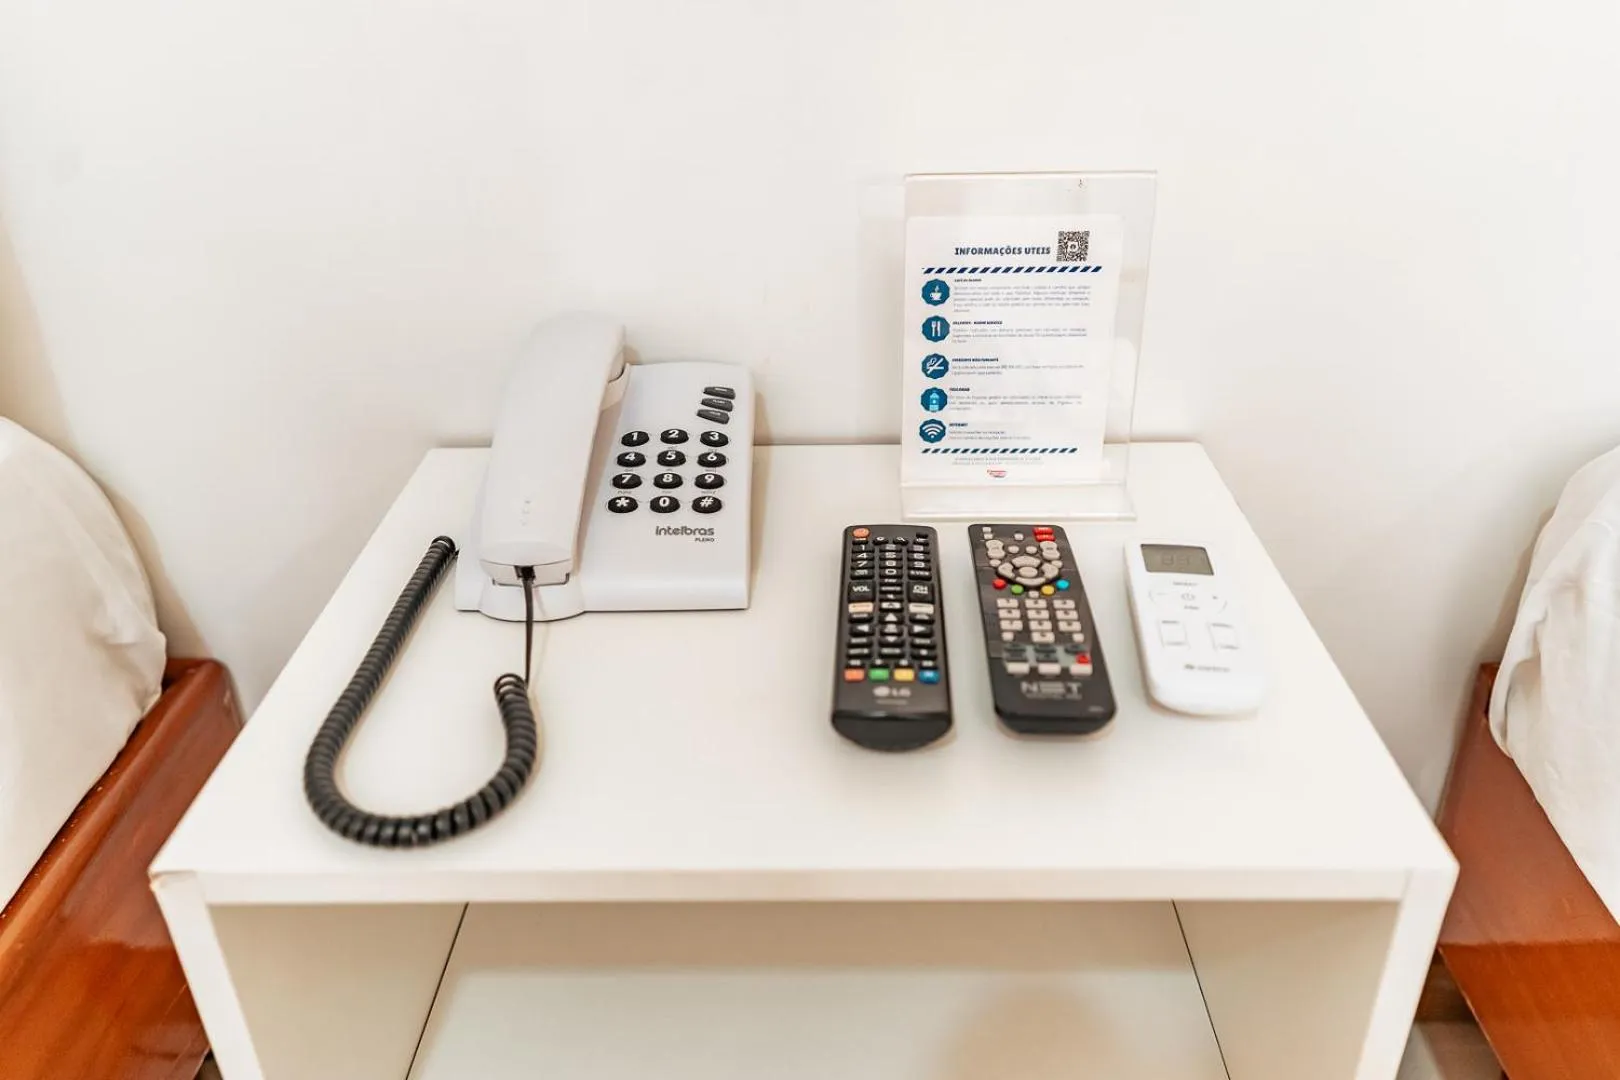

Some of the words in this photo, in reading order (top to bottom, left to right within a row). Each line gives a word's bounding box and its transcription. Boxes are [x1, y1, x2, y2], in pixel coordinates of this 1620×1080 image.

[954, 245, 1022, 256] INFORMAÇÕES
[1025, 246, 1051, 255] UTEIS
[632, 432, 638, 441] 1
[669, 430, 679, 438] 2
[709, 431, 719, 440] 3
[625, 452, 635, 460] 4
[665, 452, 676, 460] 5
[707, 453, 717, 461] 6
[621, 474, 632, 483] 7
[662, 474, 673, 482] 8
[704, 474, 715, 483] 9
[658, 497, 669, 507] 0
[655, 525, 715, 536] intelbras
